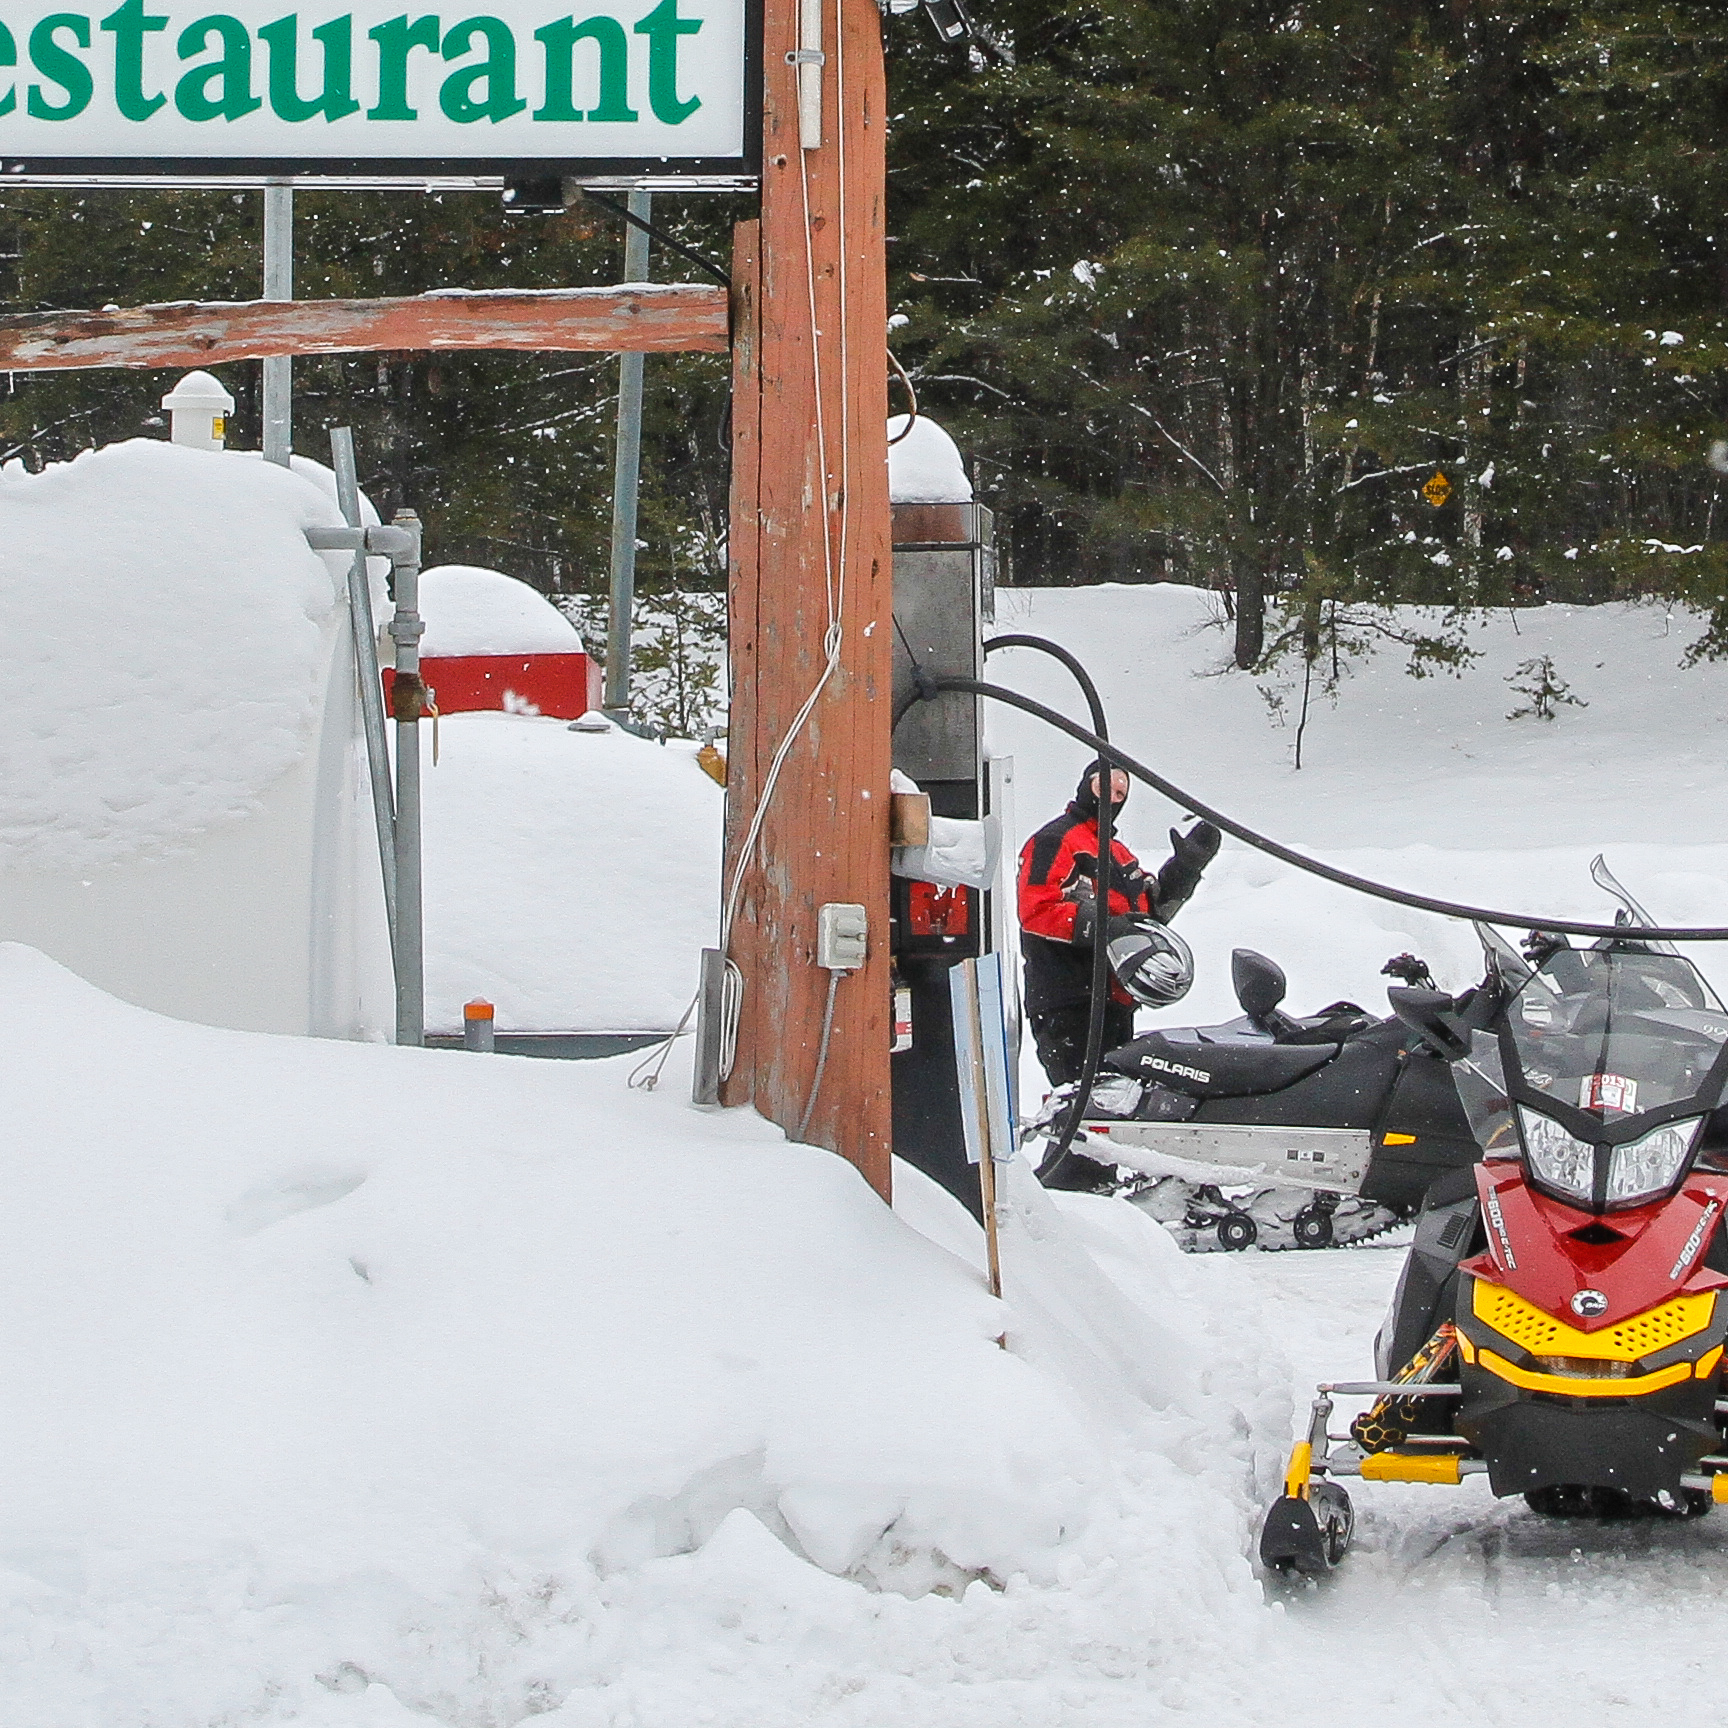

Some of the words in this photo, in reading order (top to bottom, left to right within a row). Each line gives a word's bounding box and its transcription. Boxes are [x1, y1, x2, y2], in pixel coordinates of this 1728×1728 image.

[1139, 1054, 1212, 1084] POLARIS
[1487, 1199, 1505, 1229] 600
[1679, 1232, 1702, 1266] 600
